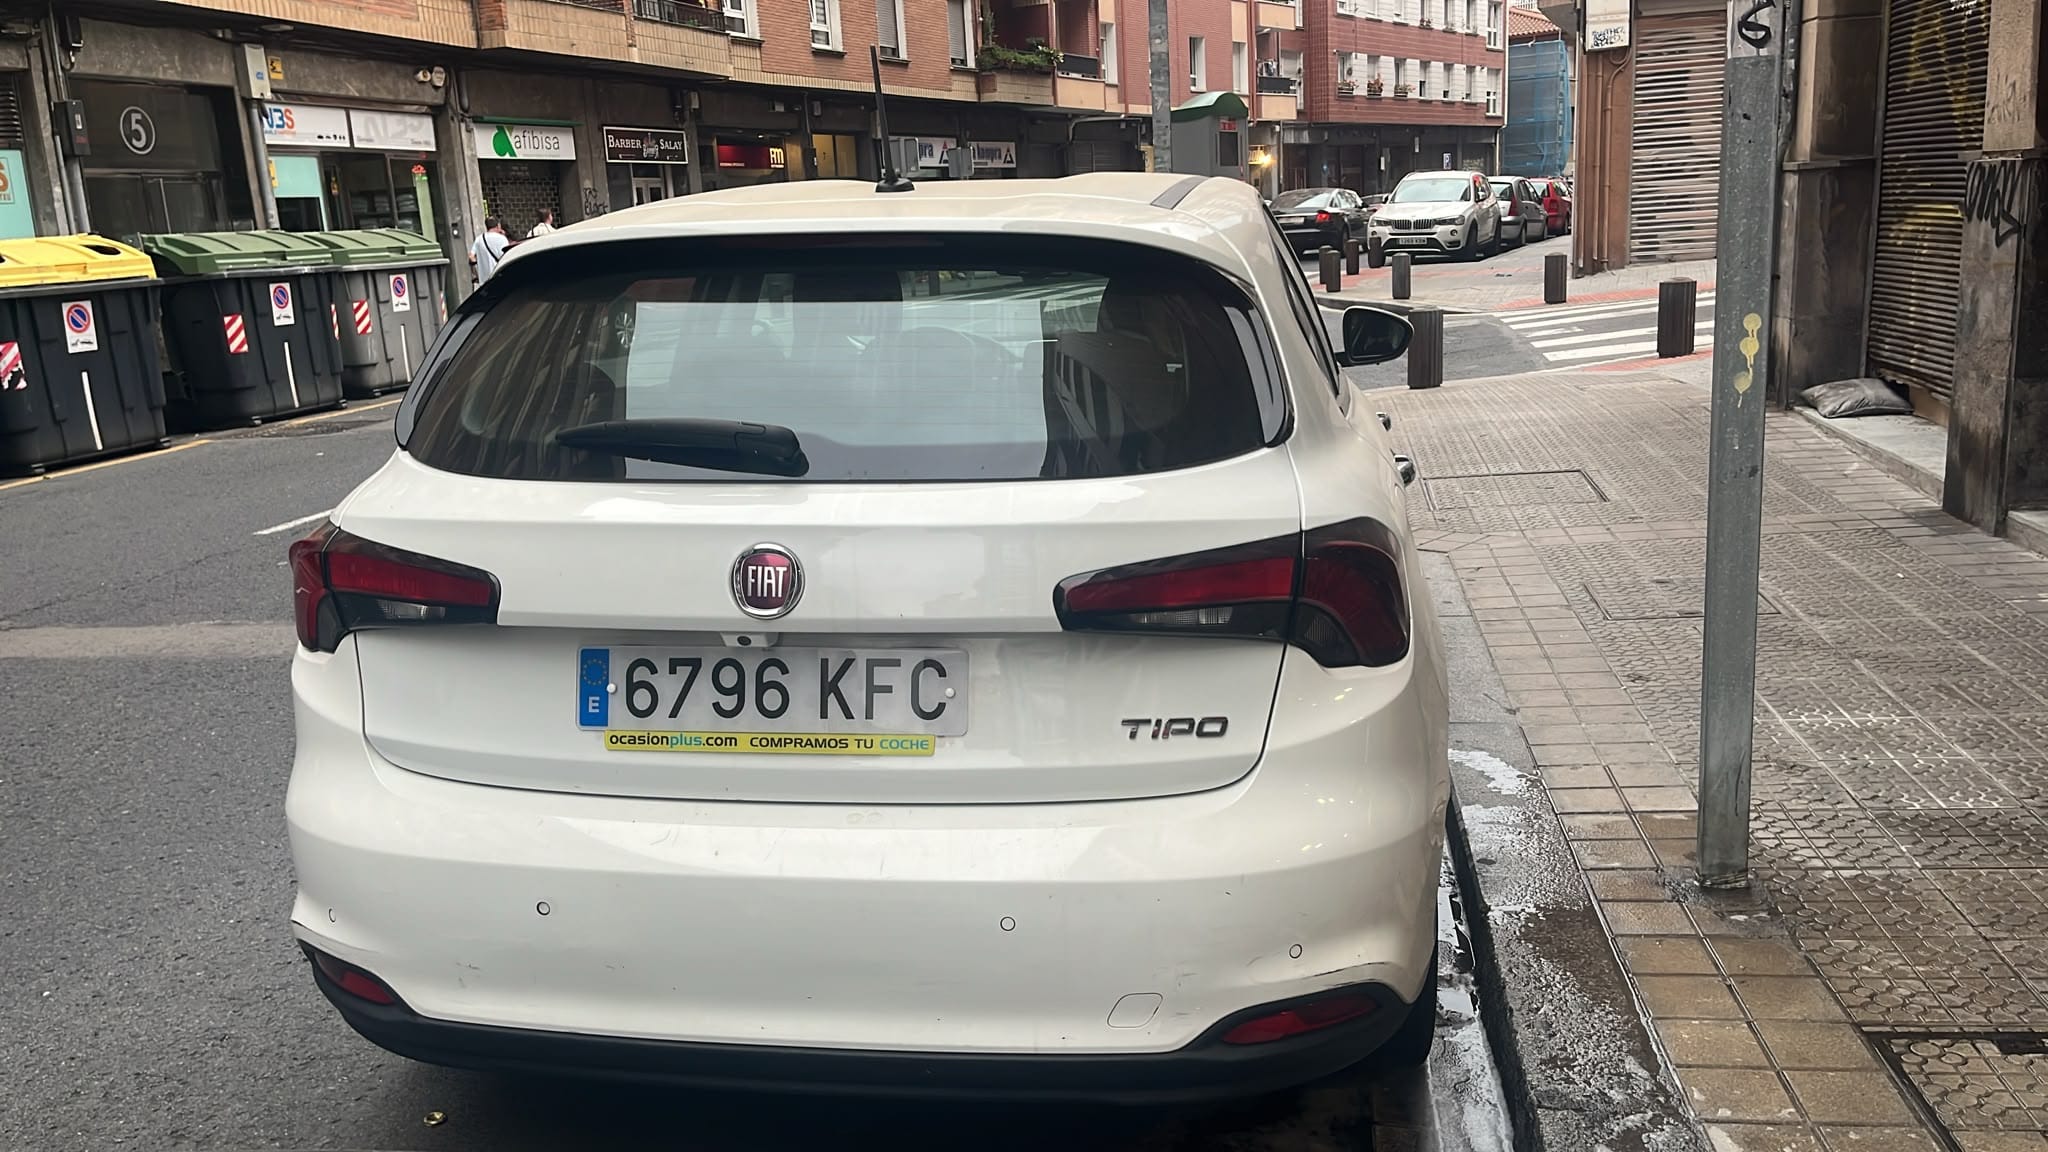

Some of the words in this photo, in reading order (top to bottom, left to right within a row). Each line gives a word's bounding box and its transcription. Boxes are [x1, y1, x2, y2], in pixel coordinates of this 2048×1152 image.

[131, 112, 147, 148] 5
[514, 130, 560, 150] afibisa
[607, 134, 642, 149] BARBER
[659, 139, 683, 151] SALAY
[747, 565, 788, 598] FIAT
[625, 657, 790, 720] 6796
[819, 657, 948, 721] KFC
[588, 696, 601, 713] E
[1121, 716, 1229, 739] TIPO
[609, 732, 738, 748] ocasionplus.com
[749, 737, 849, 749] COMPRAMOS
[854, 738, 874, 749] TU
[879, 739, 929, 750] COCHE
